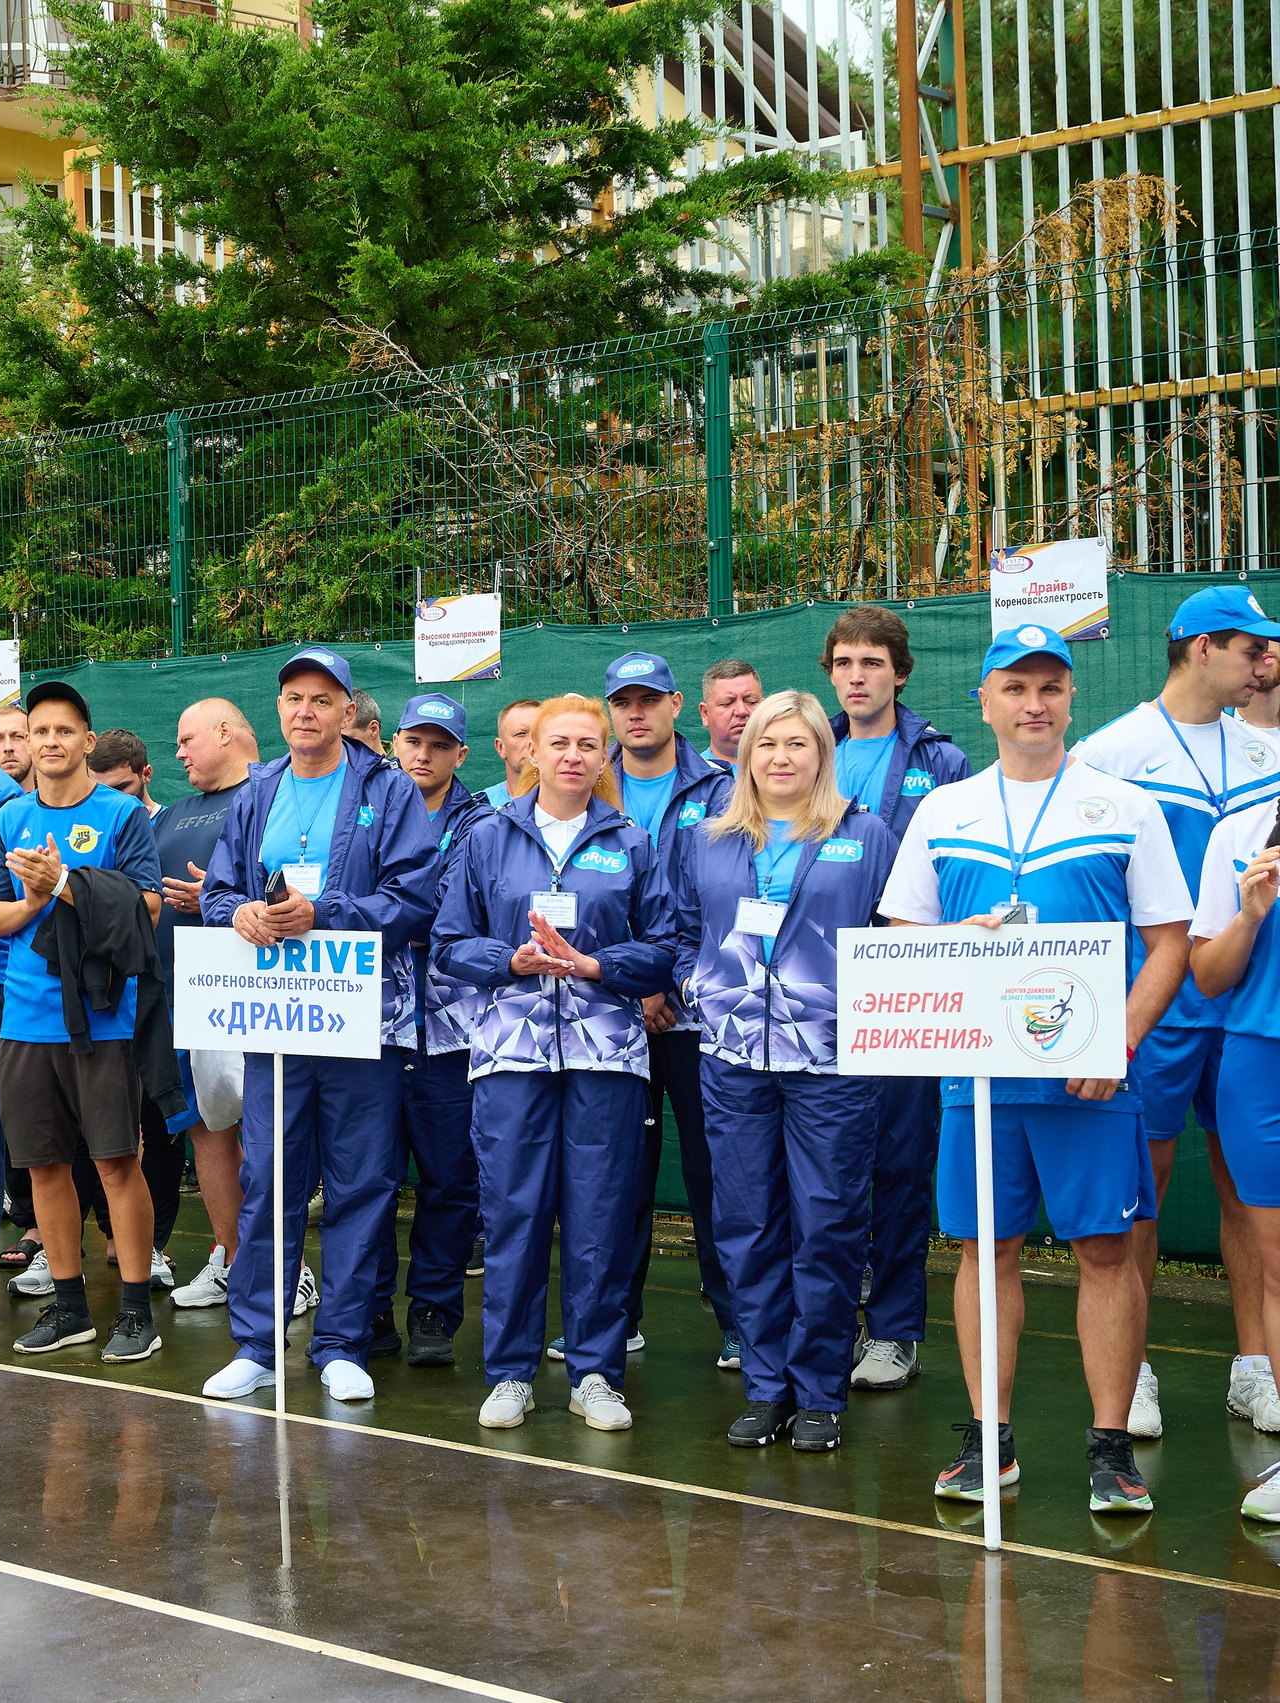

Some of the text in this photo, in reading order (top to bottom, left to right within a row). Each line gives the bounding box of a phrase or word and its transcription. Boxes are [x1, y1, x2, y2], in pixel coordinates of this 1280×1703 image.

[1022, 580, 1075, 596] «Драйв»
[995, 590, 1104, 609] Кореновскэлектросеть
[418, 630, 497, 641] «Высокое напряжение»
[620, 663, 650, 674] DRIVE
[421, 705, 450, 717] DRIVE
[580, 851, 621, 868] DRIVE
[255, 938, 376, 975] DRIVE
[853, 937, 1112, 960] ИСПОЛНИТЕЛЬНЫЙ АППАРАТ
[188, 974, 363, 992] «КОРЕНОВСКЭЛЕКТРОСЕТЬ»
[852, 992, 964, 1014] «ЭНЕРГИЯ
[208, 997, 346, 1035] «ДРАЙВ»
[850, 1028, 993, 1054] ДВИЖЕНИЯ»
